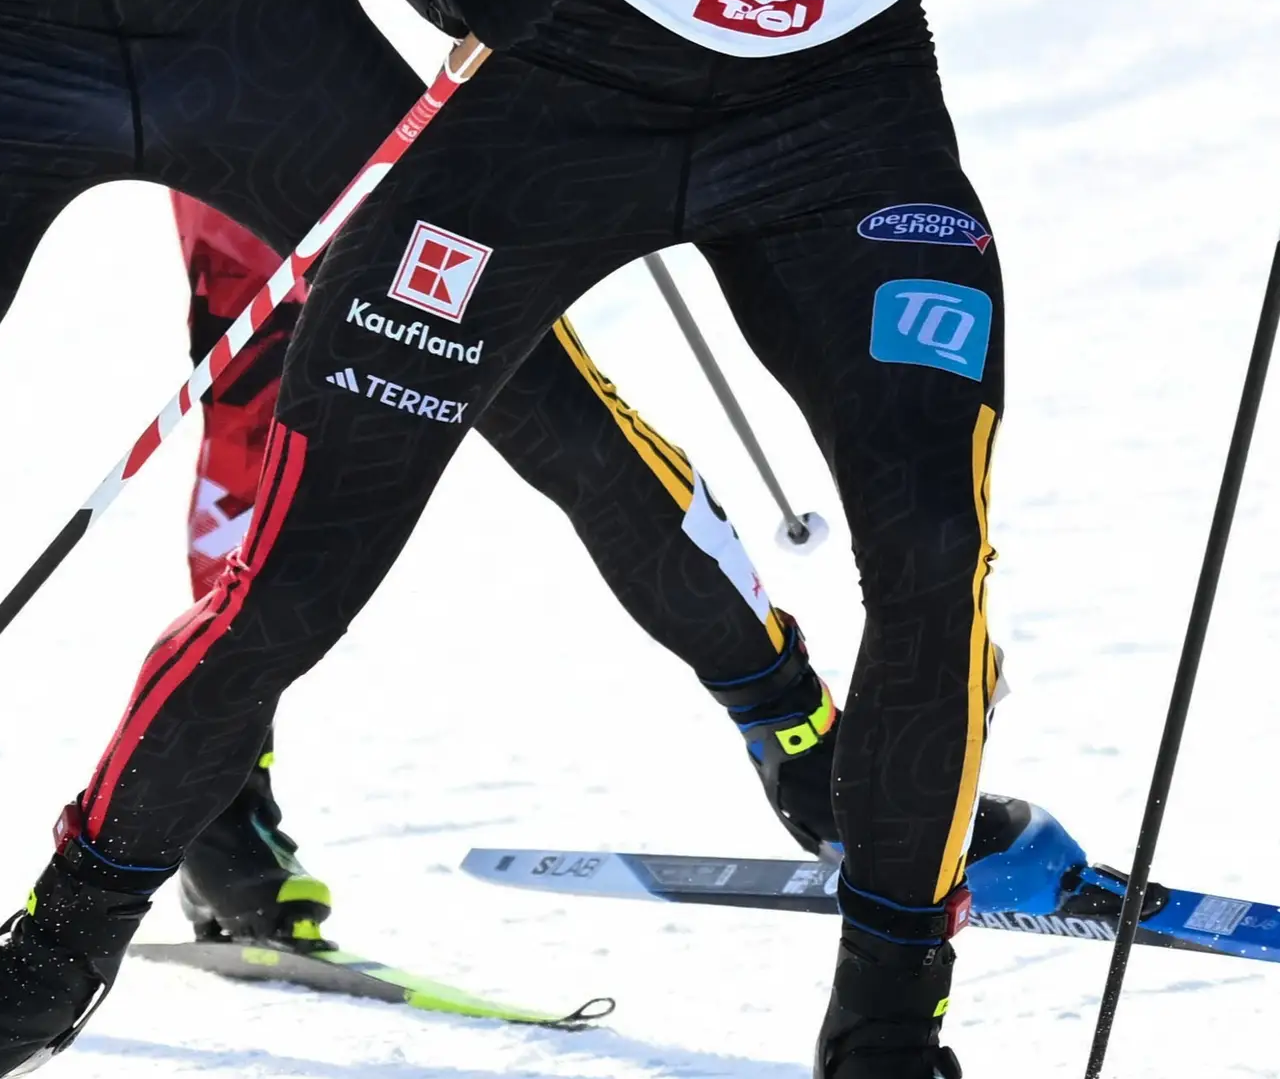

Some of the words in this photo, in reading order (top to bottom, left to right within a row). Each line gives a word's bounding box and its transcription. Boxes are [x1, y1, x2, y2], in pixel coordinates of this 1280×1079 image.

[869, 212, 976, 232] personal
[893, 222, 955, 238] shop
[346, 297, 484, 365] Kaufland
[894, 291, 976, 365] TQ
[366, 374, 469, 424] TERREX
[968, 910, 1118, 941] SALOMON
